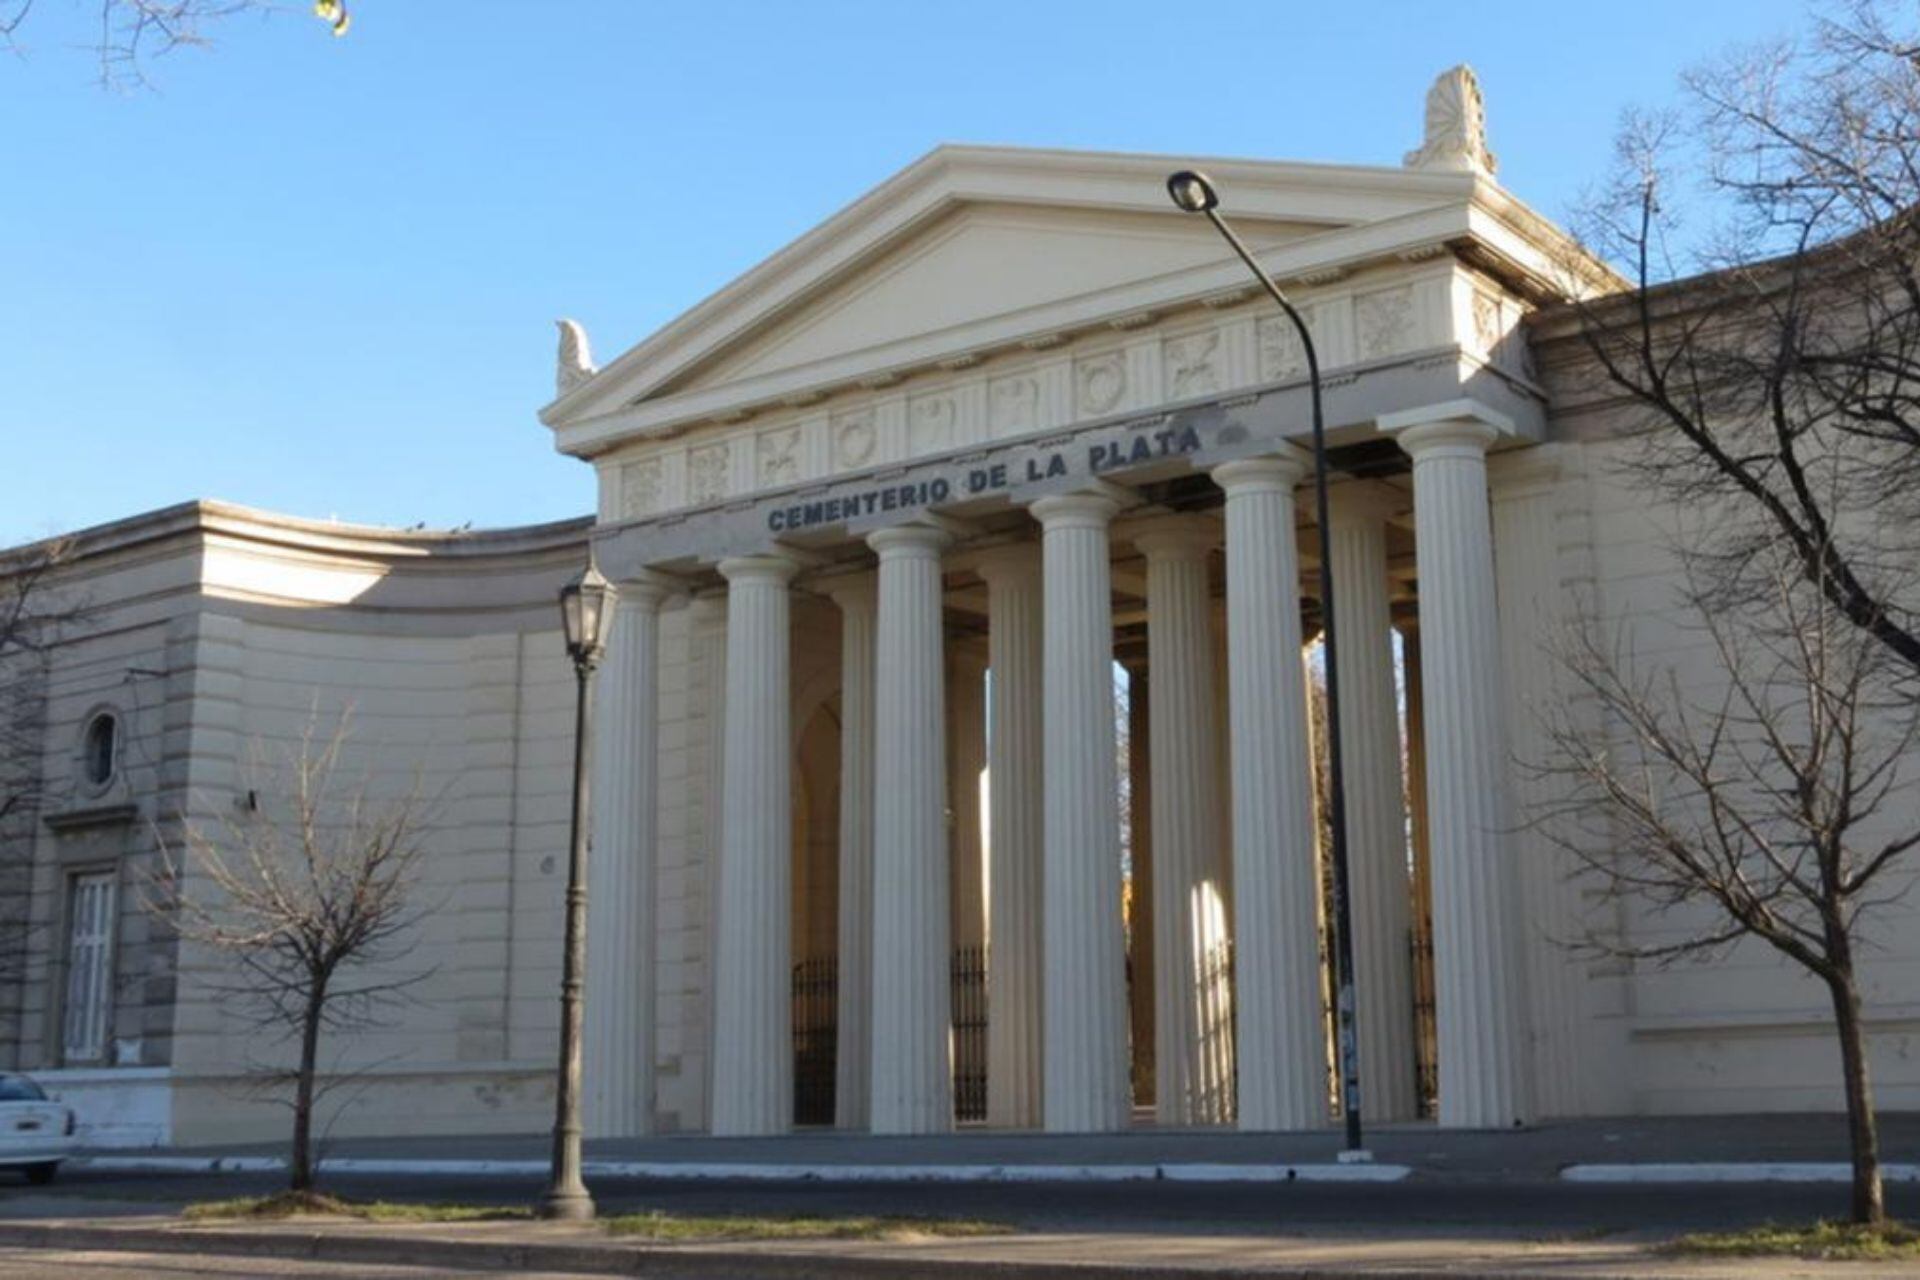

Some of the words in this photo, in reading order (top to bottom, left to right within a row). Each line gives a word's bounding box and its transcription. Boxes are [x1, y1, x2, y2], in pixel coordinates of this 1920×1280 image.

[768, 478, 949, 531] CEMENTERIO
[969, 464, 1007, 493] DE
[1027, 454, 1067, 482] LA
[1089, 426, 1201, 471] PLATA
